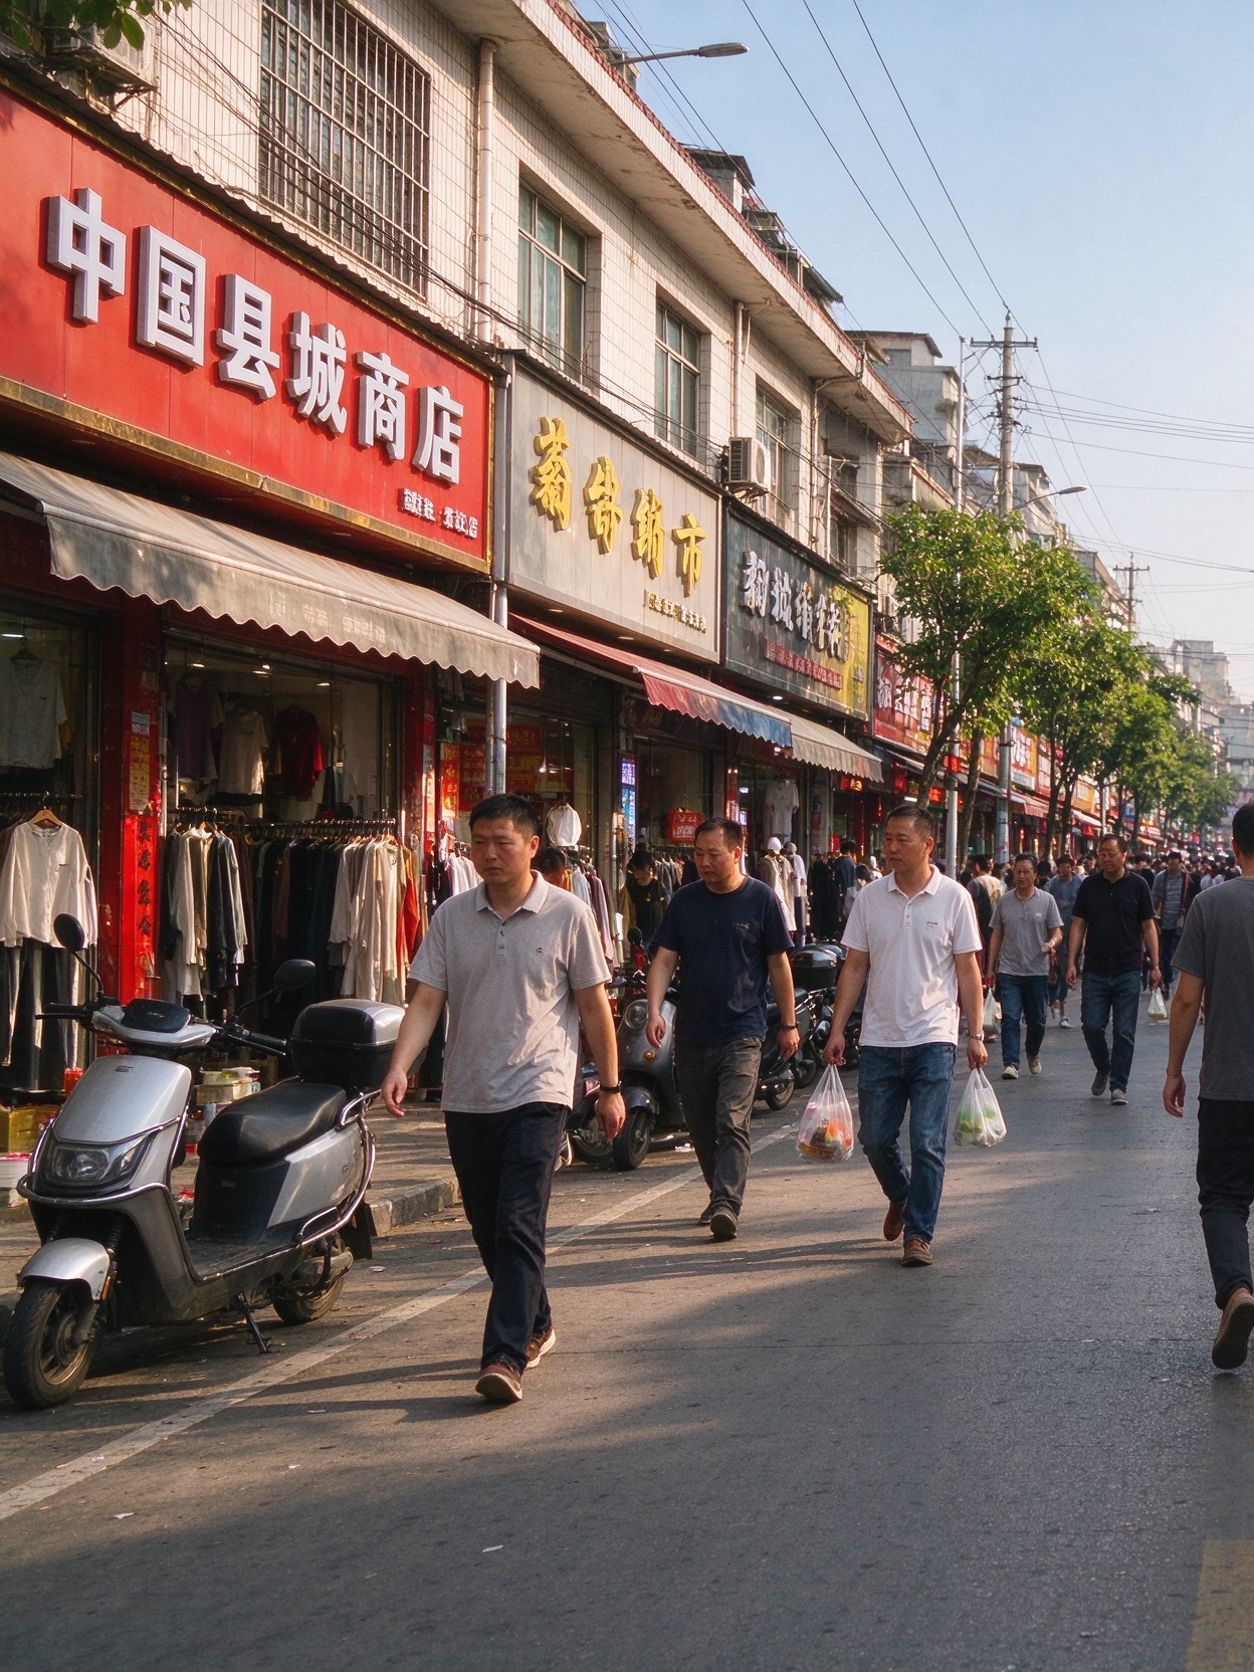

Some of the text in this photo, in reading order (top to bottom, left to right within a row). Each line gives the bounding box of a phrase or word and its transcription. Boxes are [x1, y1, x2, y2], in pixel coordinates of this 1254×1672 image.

[47, 187, 464, 486] 中国县城商店
